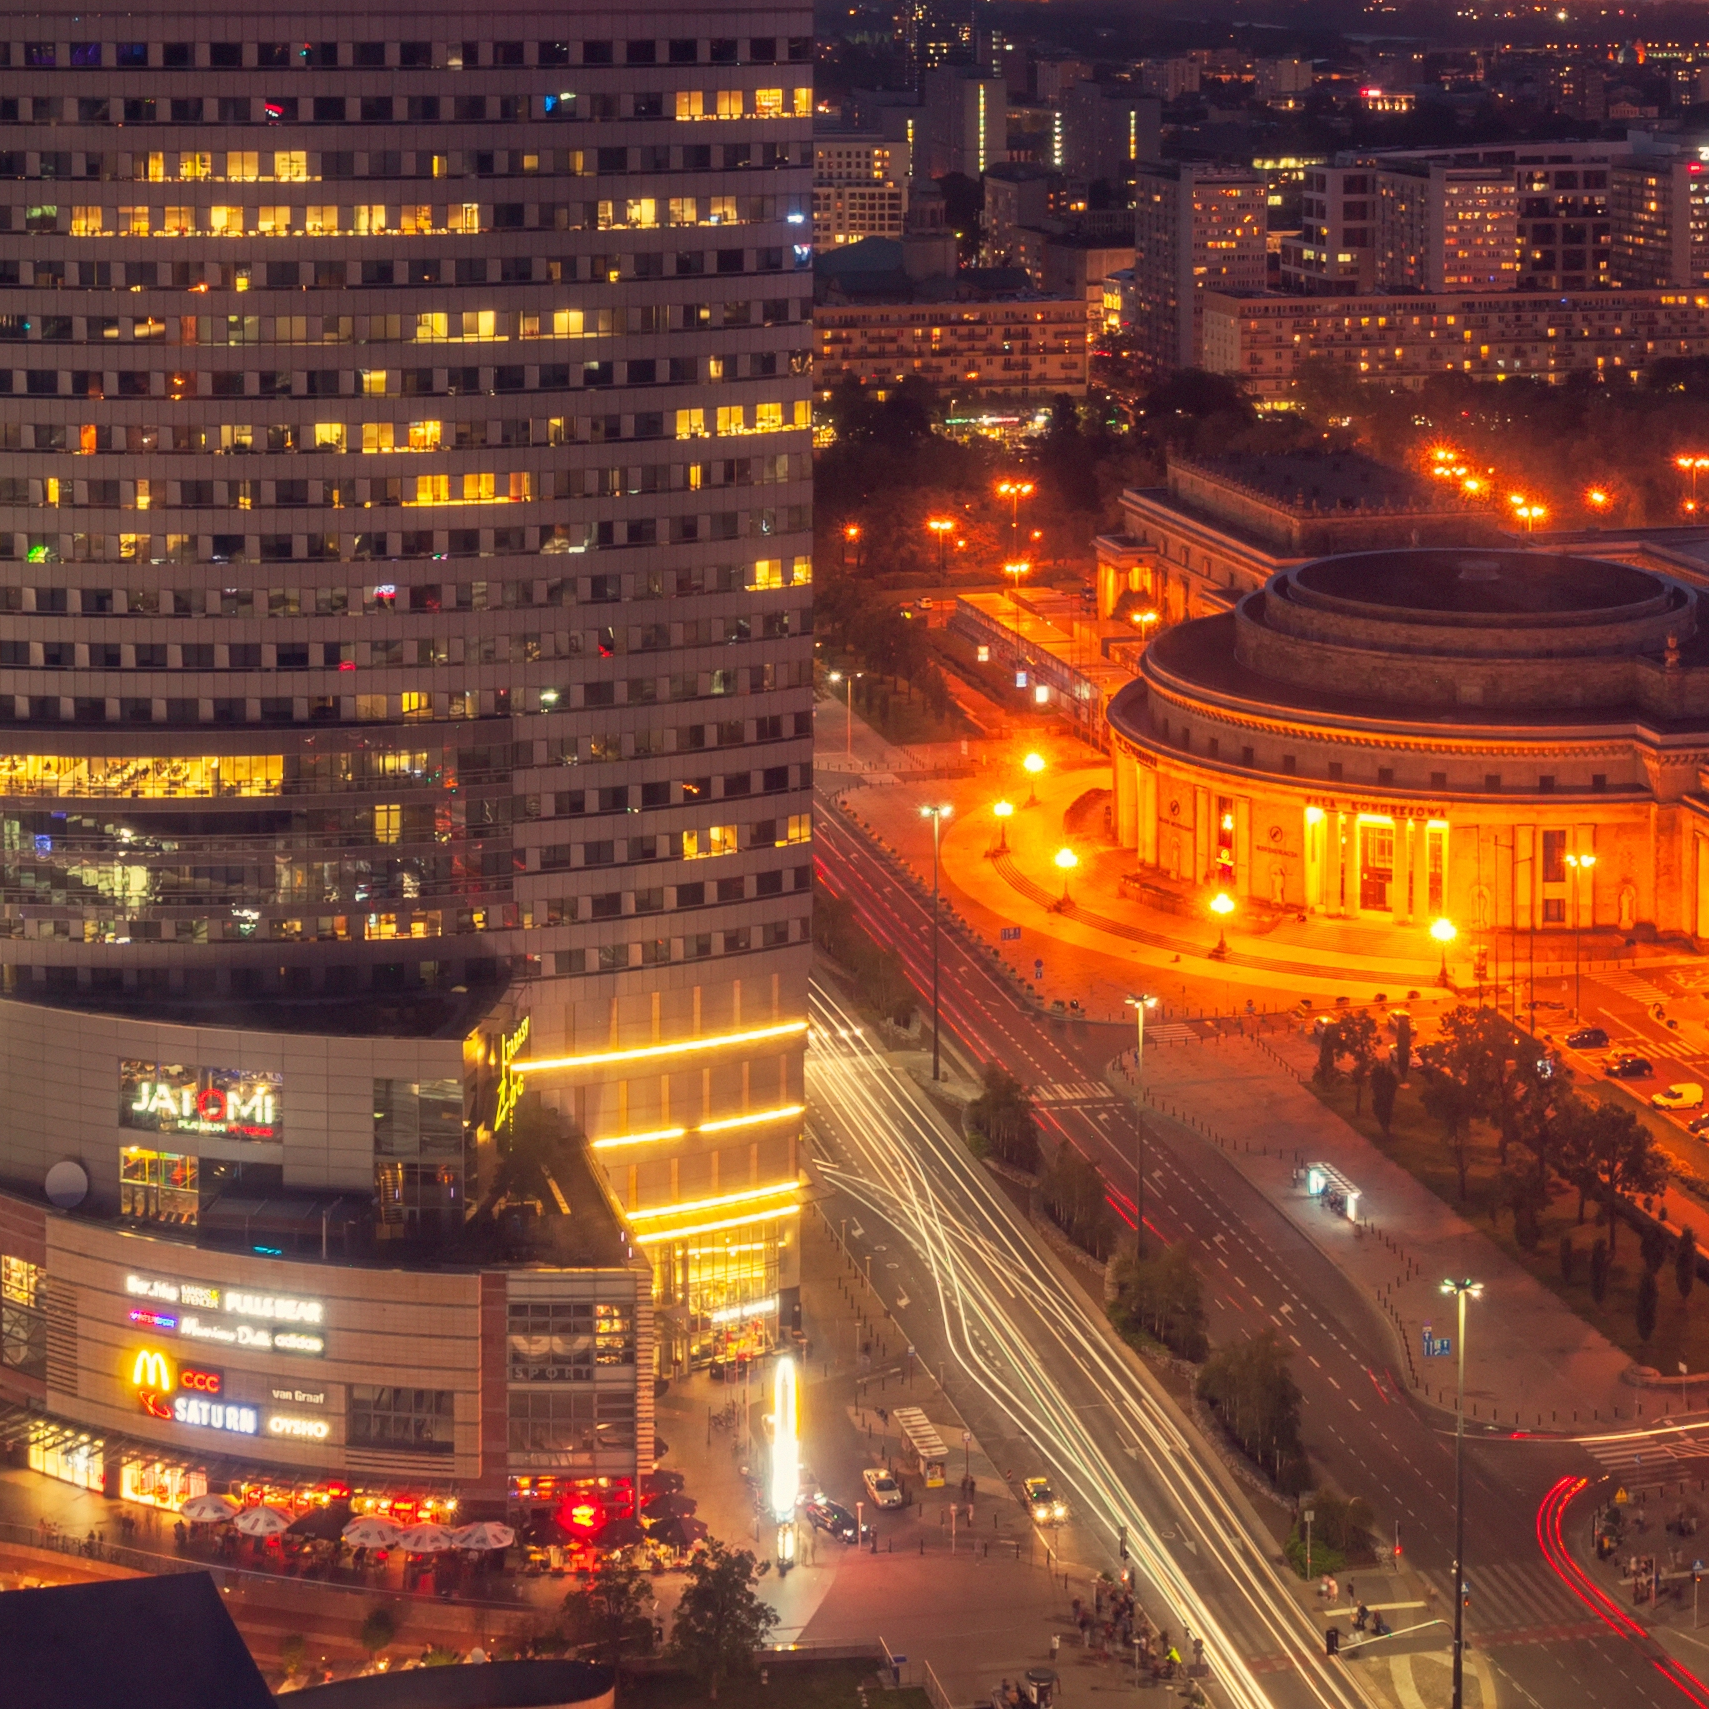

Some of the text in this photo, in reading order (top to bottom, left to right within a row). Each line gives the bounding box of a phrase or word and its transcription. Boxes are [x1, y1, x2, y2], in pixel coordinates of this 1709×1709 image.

[1351, 801, 1447, 818] KONGRESOWA
[181, 1369, 221, 1393] CCC
[515, 1368, 589, 1379] SPORT
[272, 1389, 324, 1404] van Graaf
[174, 1397, 257, 1434] SATURN
[269, 1416, 329, 1438] OYSHO
